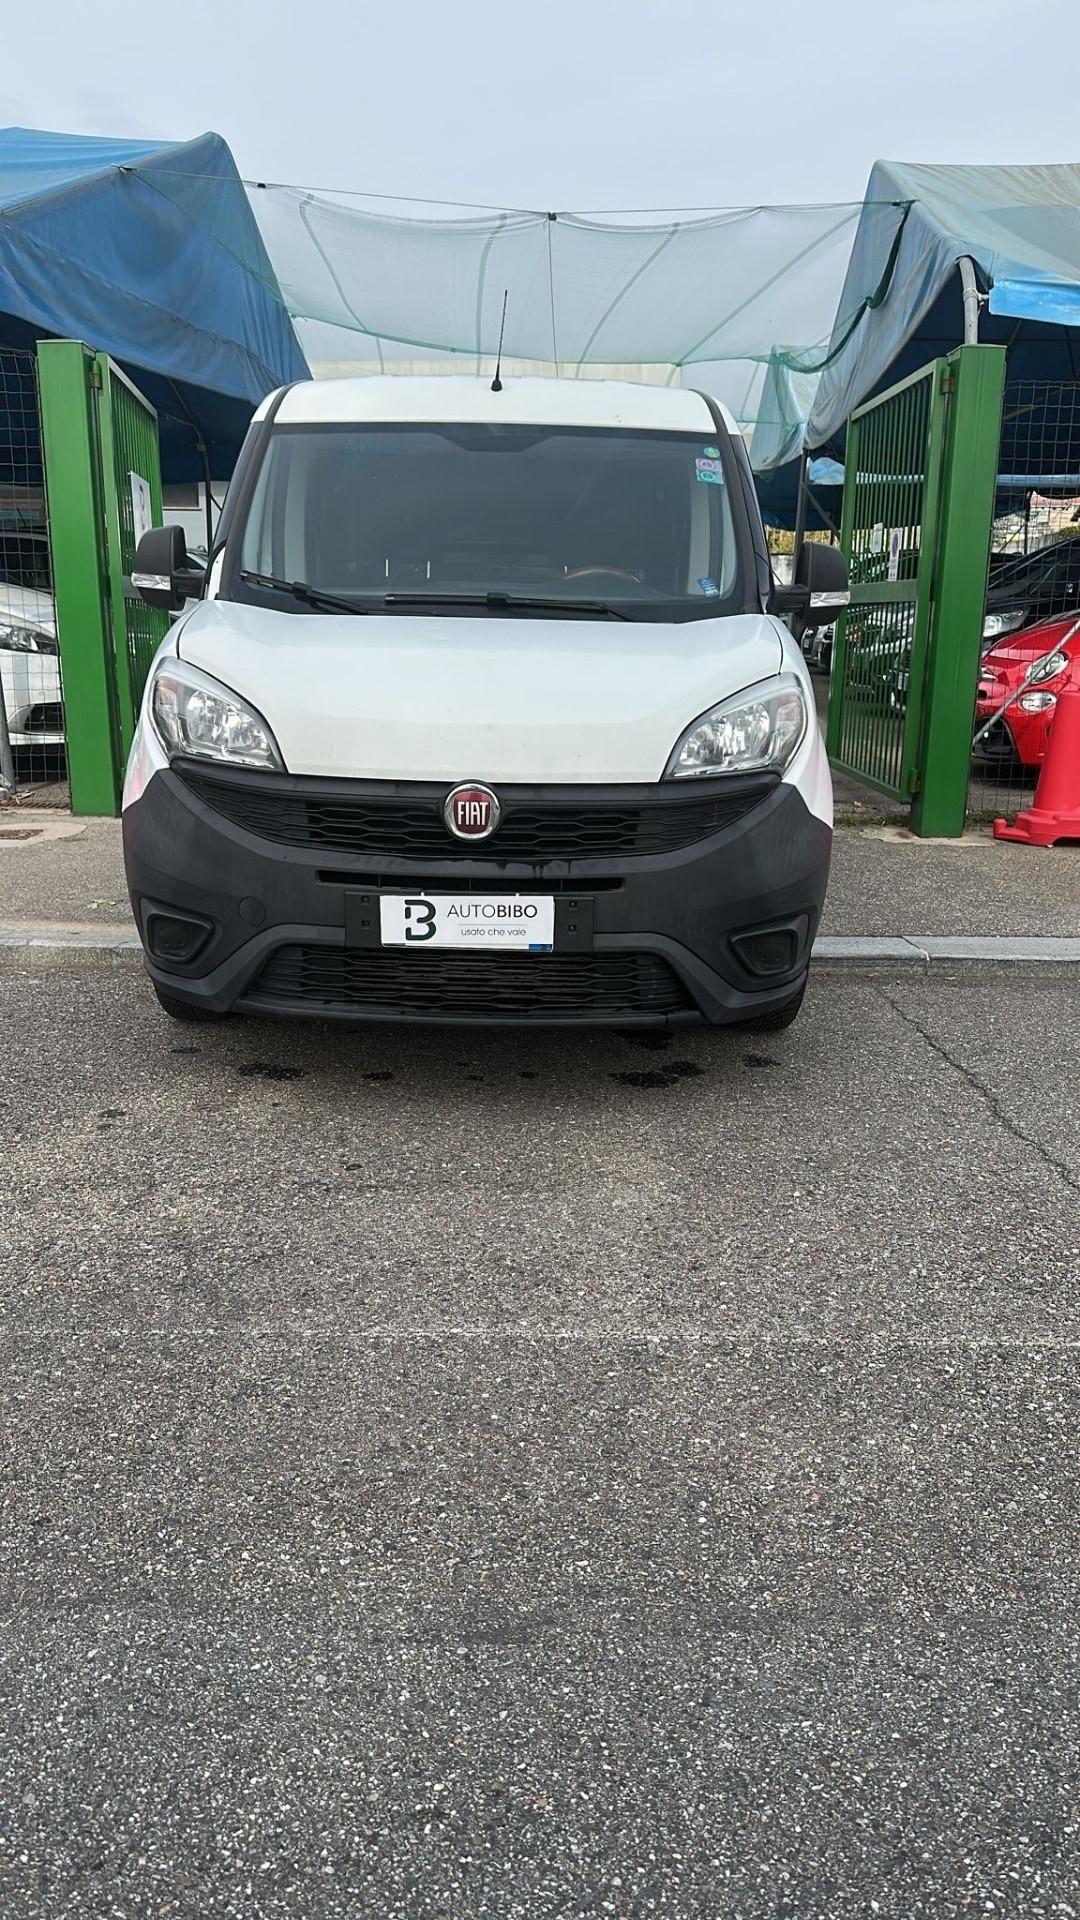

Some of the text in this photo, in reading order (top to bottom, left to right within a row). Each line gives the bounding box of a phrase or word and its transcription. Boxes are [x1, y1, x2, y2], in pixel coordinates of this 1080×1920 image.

[457, 801, 489, 826] FIAT
[446, 904, 538, 918] AUTOBIBO
[460, 928, 527, 936] usato che vale
